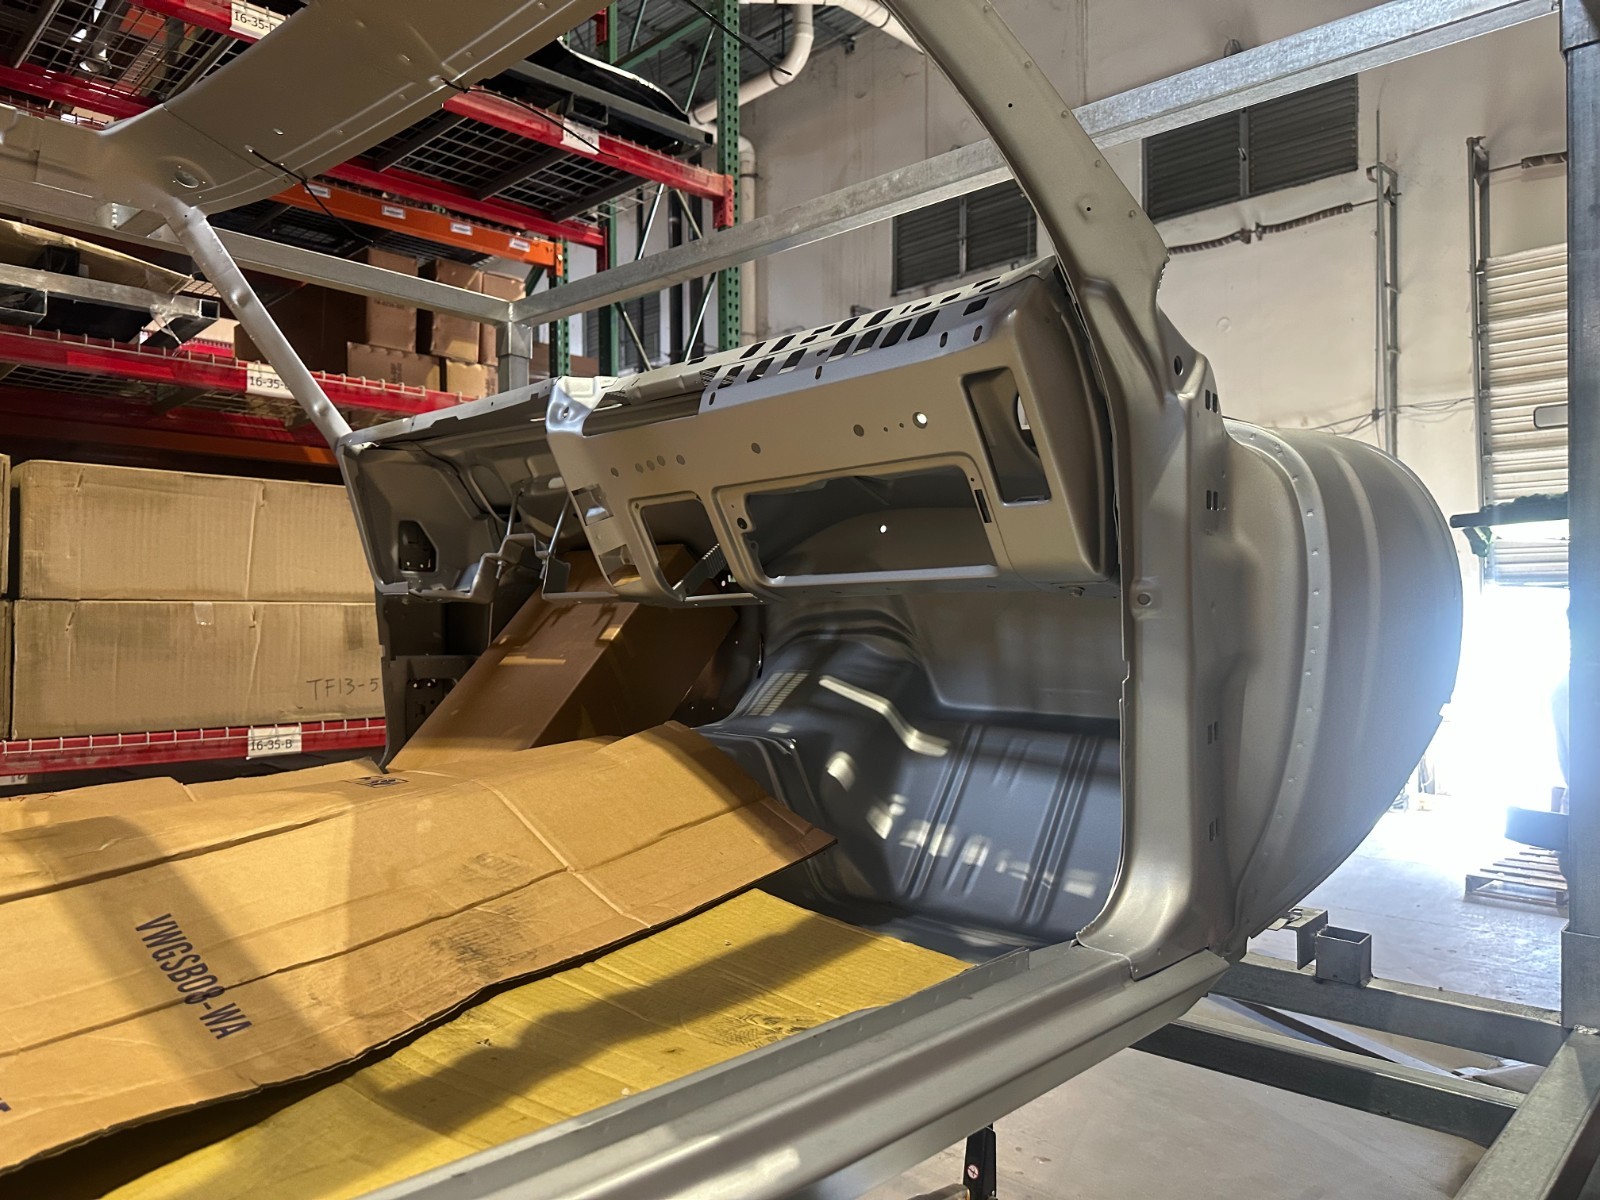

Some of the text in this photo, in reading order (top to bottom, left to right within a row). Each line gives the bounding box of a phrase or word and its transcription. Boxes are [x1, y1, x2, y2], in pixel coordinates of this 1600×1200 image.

[250, 376, 289, 390] 16-35-
[306, 678, 380, 701] TF13-5
[251, 739, 292, 750] 16-35-B
[135, 913, 252, 1040] VWGSB08-WA
